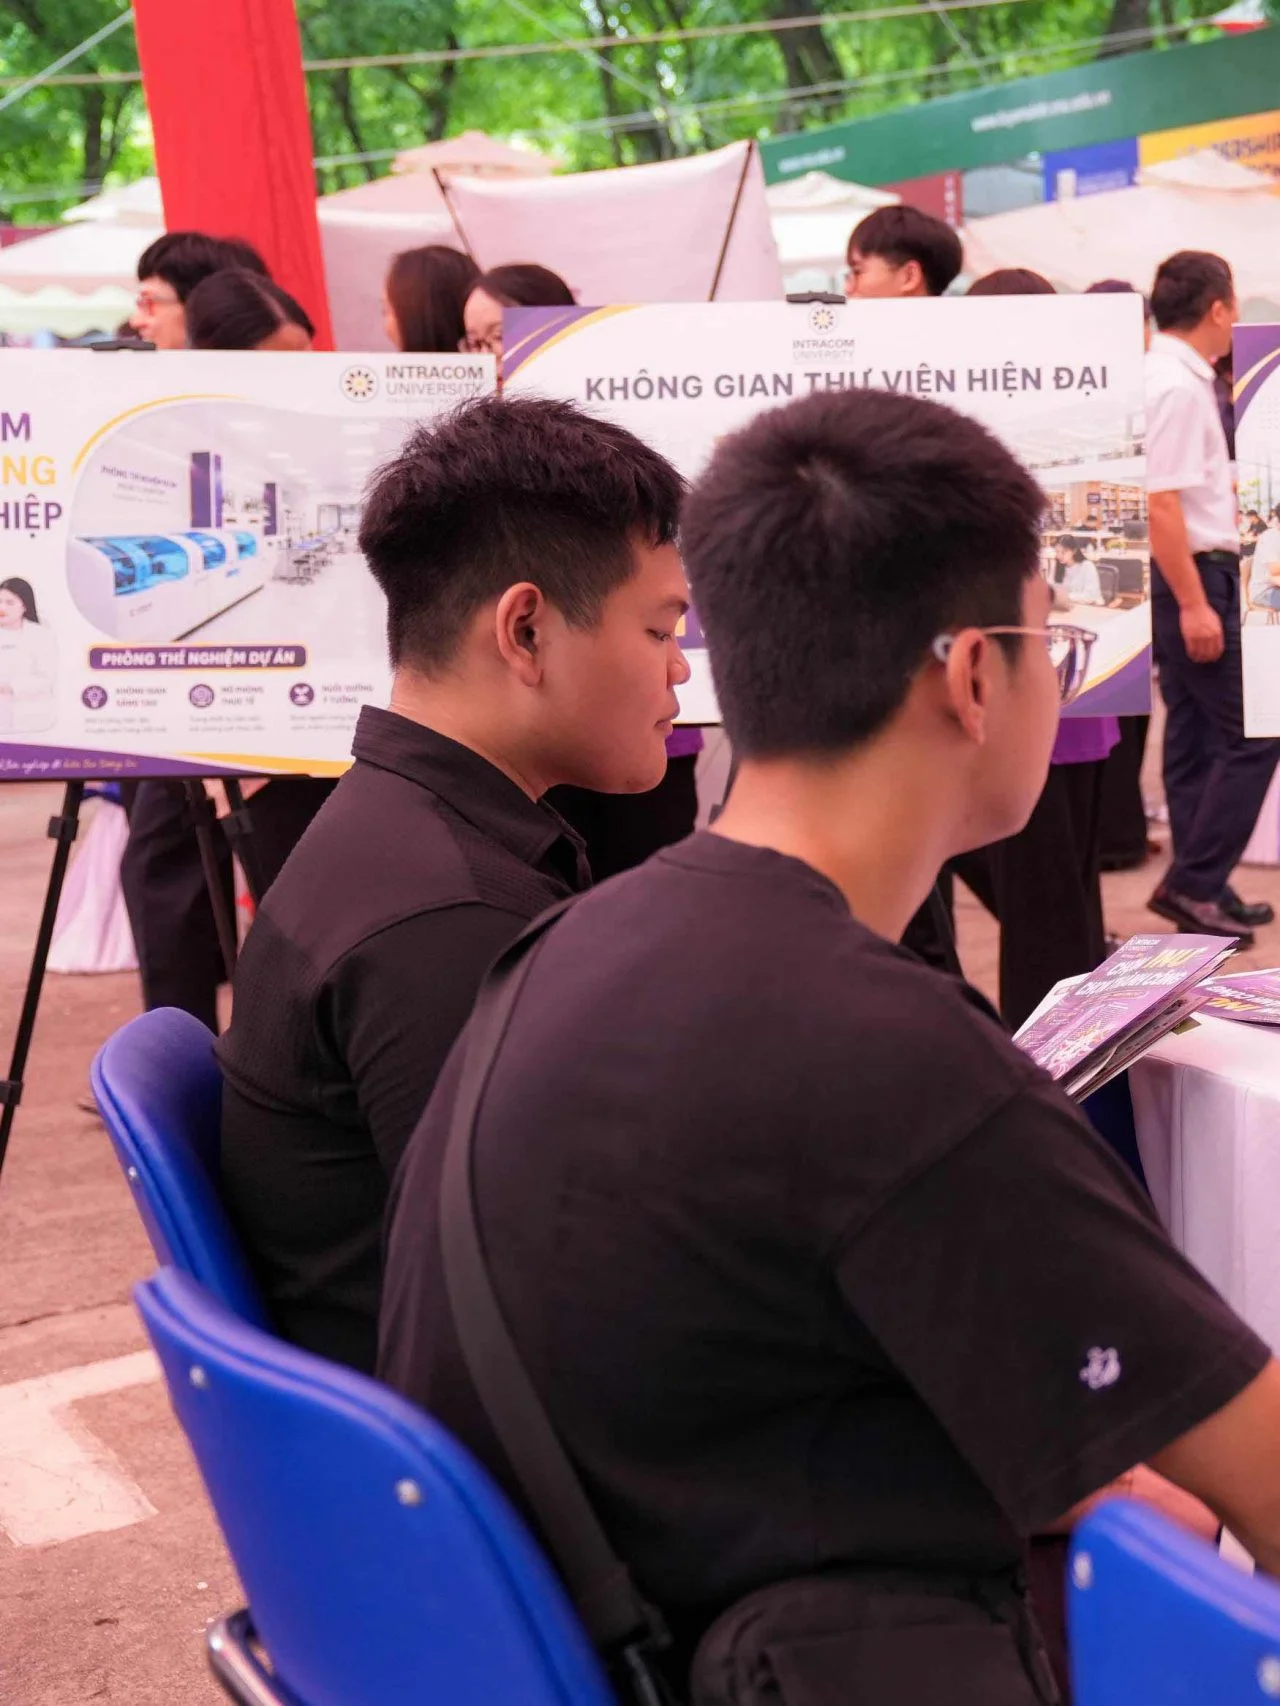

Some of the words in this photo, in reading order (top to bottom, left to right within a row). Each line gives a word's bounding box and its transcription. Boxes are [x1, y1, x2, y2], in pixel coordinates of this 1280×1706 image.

[386, 366, 484, 379] INTRACOM
[586, 369, 702, 401] KHÔNG
[714, 373, 794, 398] GIAN
[968, 361, 1042, 398] HIỆN
[1054, 366, 1108, 396] ĐẠI
[386, 382, 482, 395] UNIVERSITY
[1, 412, 30, 441] M
[3, 456, 56, 487] NG
